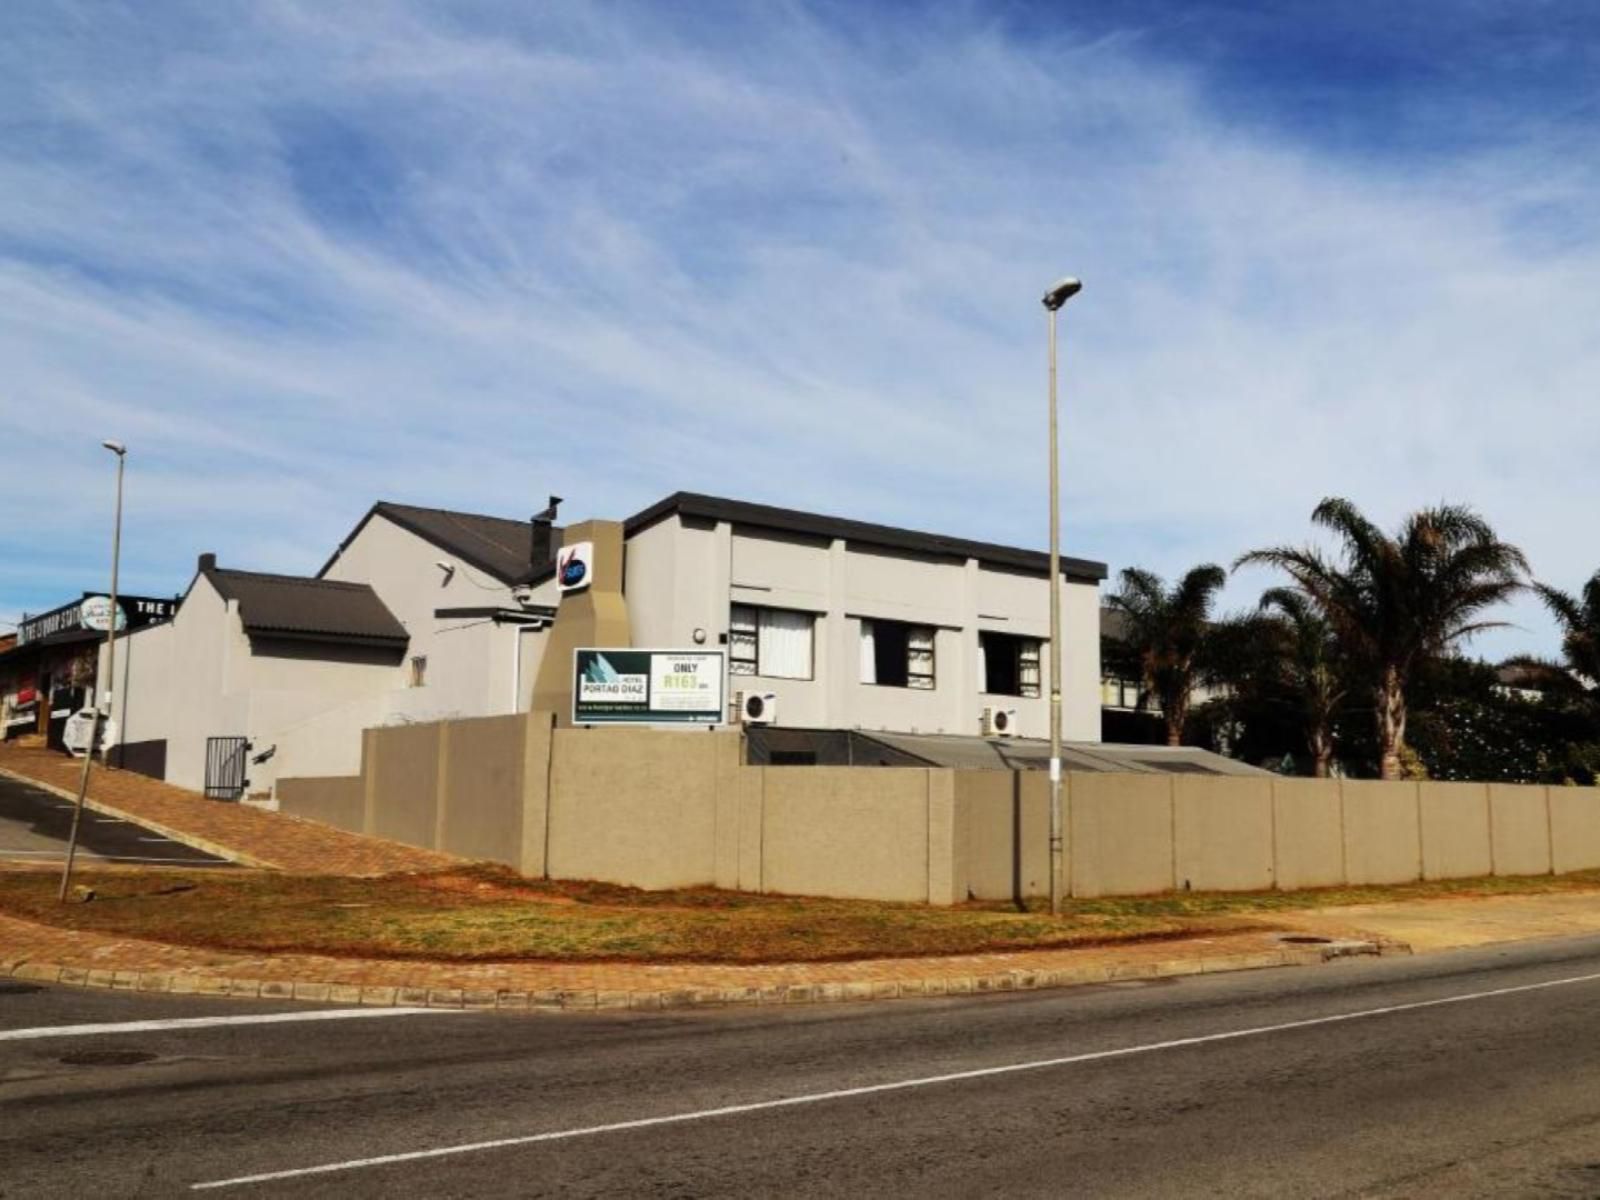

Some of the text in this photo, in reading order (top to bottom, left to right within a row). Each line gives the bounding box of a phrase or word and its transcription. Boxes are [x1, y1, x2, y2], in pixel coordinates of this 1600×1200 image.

[136, 601, 165, 615] THE
[673, 663, 698, 673] ONLY
[621, 684, 644, 694] DIAZ
